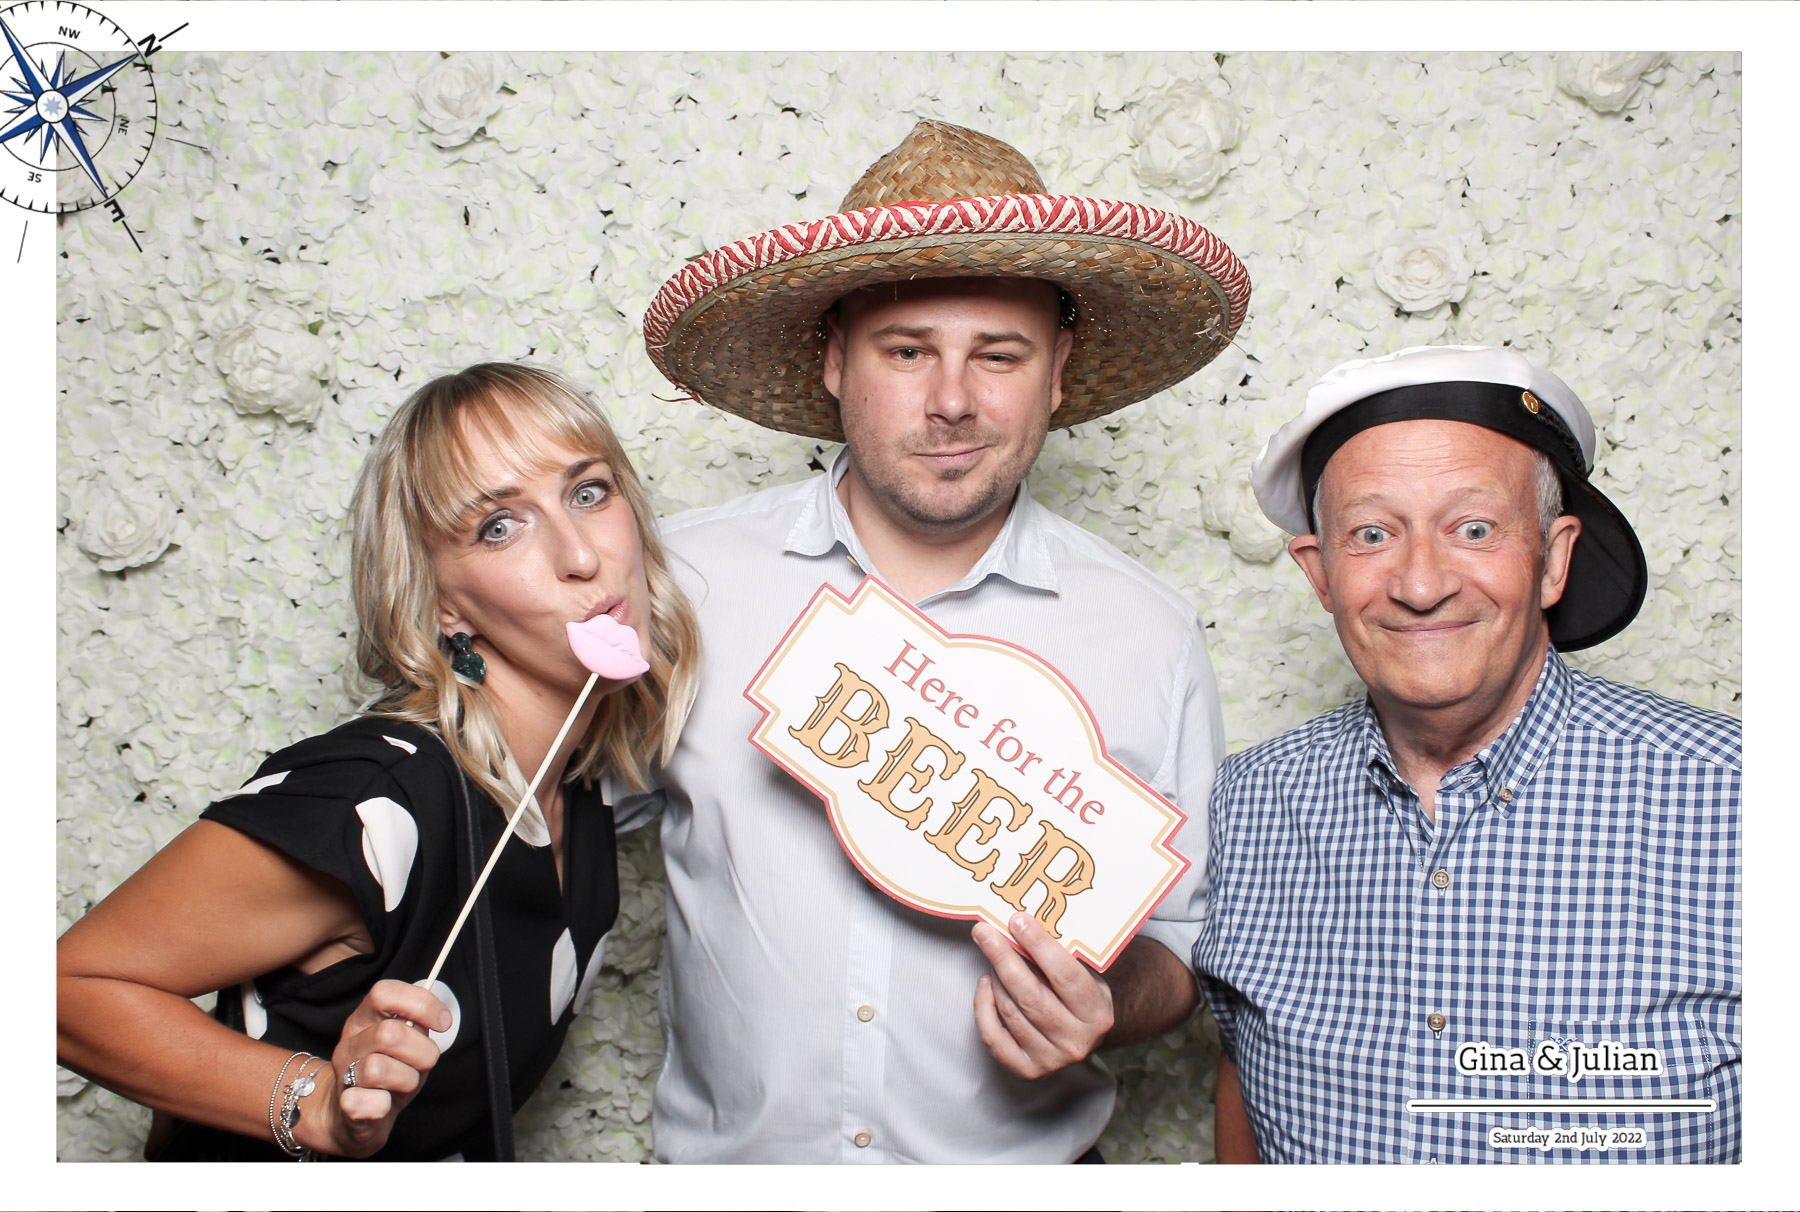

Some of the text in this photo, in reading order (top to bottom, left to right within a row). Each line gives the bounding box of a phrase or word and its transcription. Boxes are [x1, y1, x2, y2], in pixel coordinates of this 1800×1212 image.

[787, 662, 1096, 940] BEER
[883, 639, 1106, 826] Here for the
